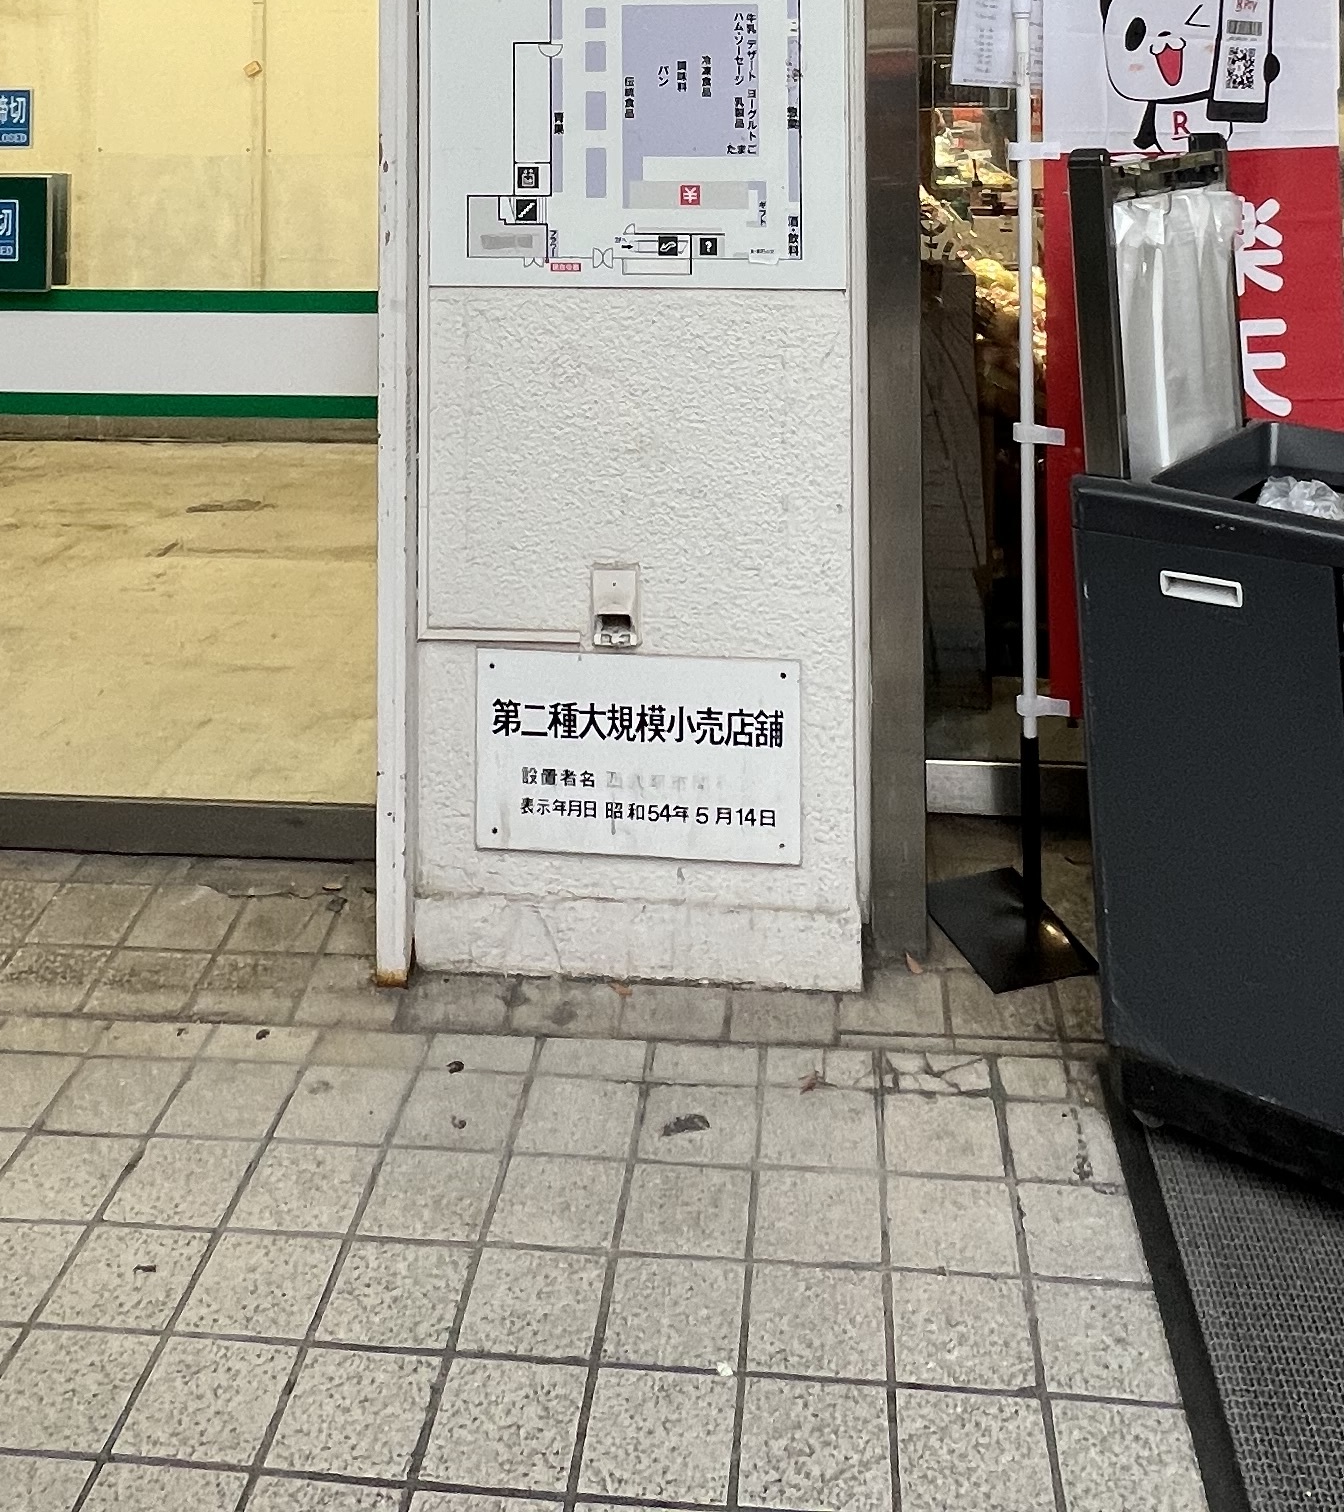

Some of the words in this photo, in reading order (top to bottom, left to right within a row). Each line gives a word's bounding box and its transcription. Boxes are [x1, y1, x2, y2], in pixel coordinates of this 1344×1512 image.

[747, 40, 756, 81] デザート
[658, 65, 669, 87] パン
[747, 89, 757, 141] ヨーグルト
[1171, 111, 1189, 135] R
[727, 144, 756, 155] たまご
[492, 698, 784, 748] 第二種大規模小売店舗
[521, 766, 596, 788] 設置者名
[520, 797, 597, 819] 表示年月日
